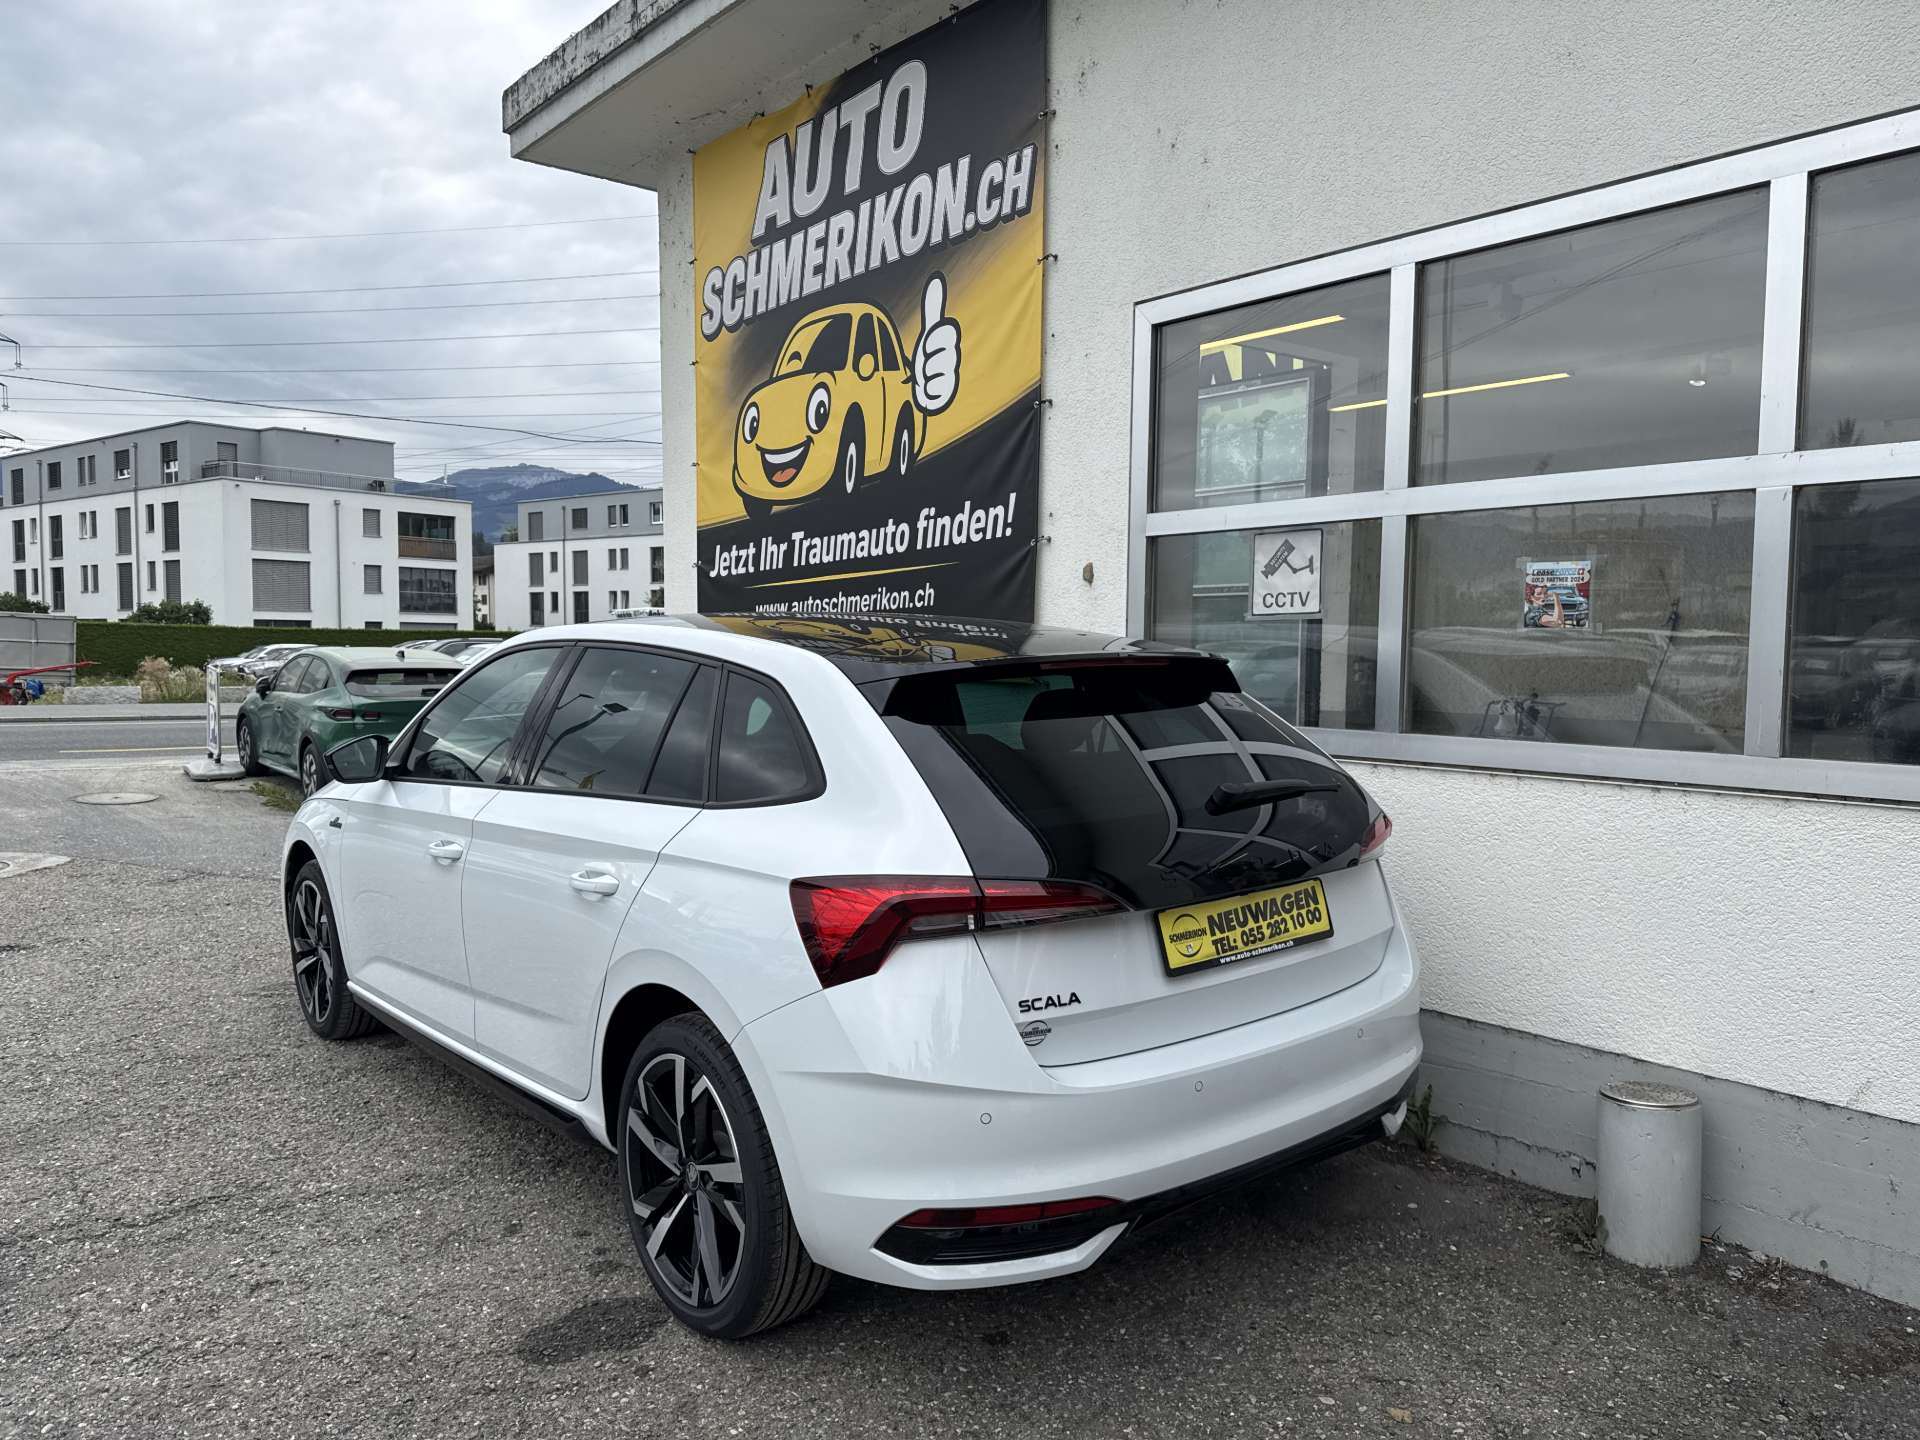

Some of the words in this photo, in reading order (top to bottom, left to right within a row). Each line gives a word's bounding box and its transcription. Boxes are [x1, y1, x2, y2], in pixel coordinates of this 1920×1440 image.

[752, 59, 928, 241] AUTO
[701, 144, 1036, 339] SCHMERIKON.CH
[709, 544, 755, 578] Jetzt
[759, 535, 787, 572] Ihr
[791, 518, 909, 567] Traumauto
[916, 492, 1017, 549] finden!
[1262, 591, 1310, 609] CCTV
[1169, 927, 1208, 944] SCHMERIKON
[1207, 885, 1320, 936] NEUWAGEN
[1212, 935, 1238, 956] TEL:
[1240, 925, 1266, 947] 055
[1266, 917, 1290, 940] 282
[1290, 911, 1306, 930] 10
[1307, 907, 1322, 926] 00
[1018, 992, 1081, 1014] SCALA
